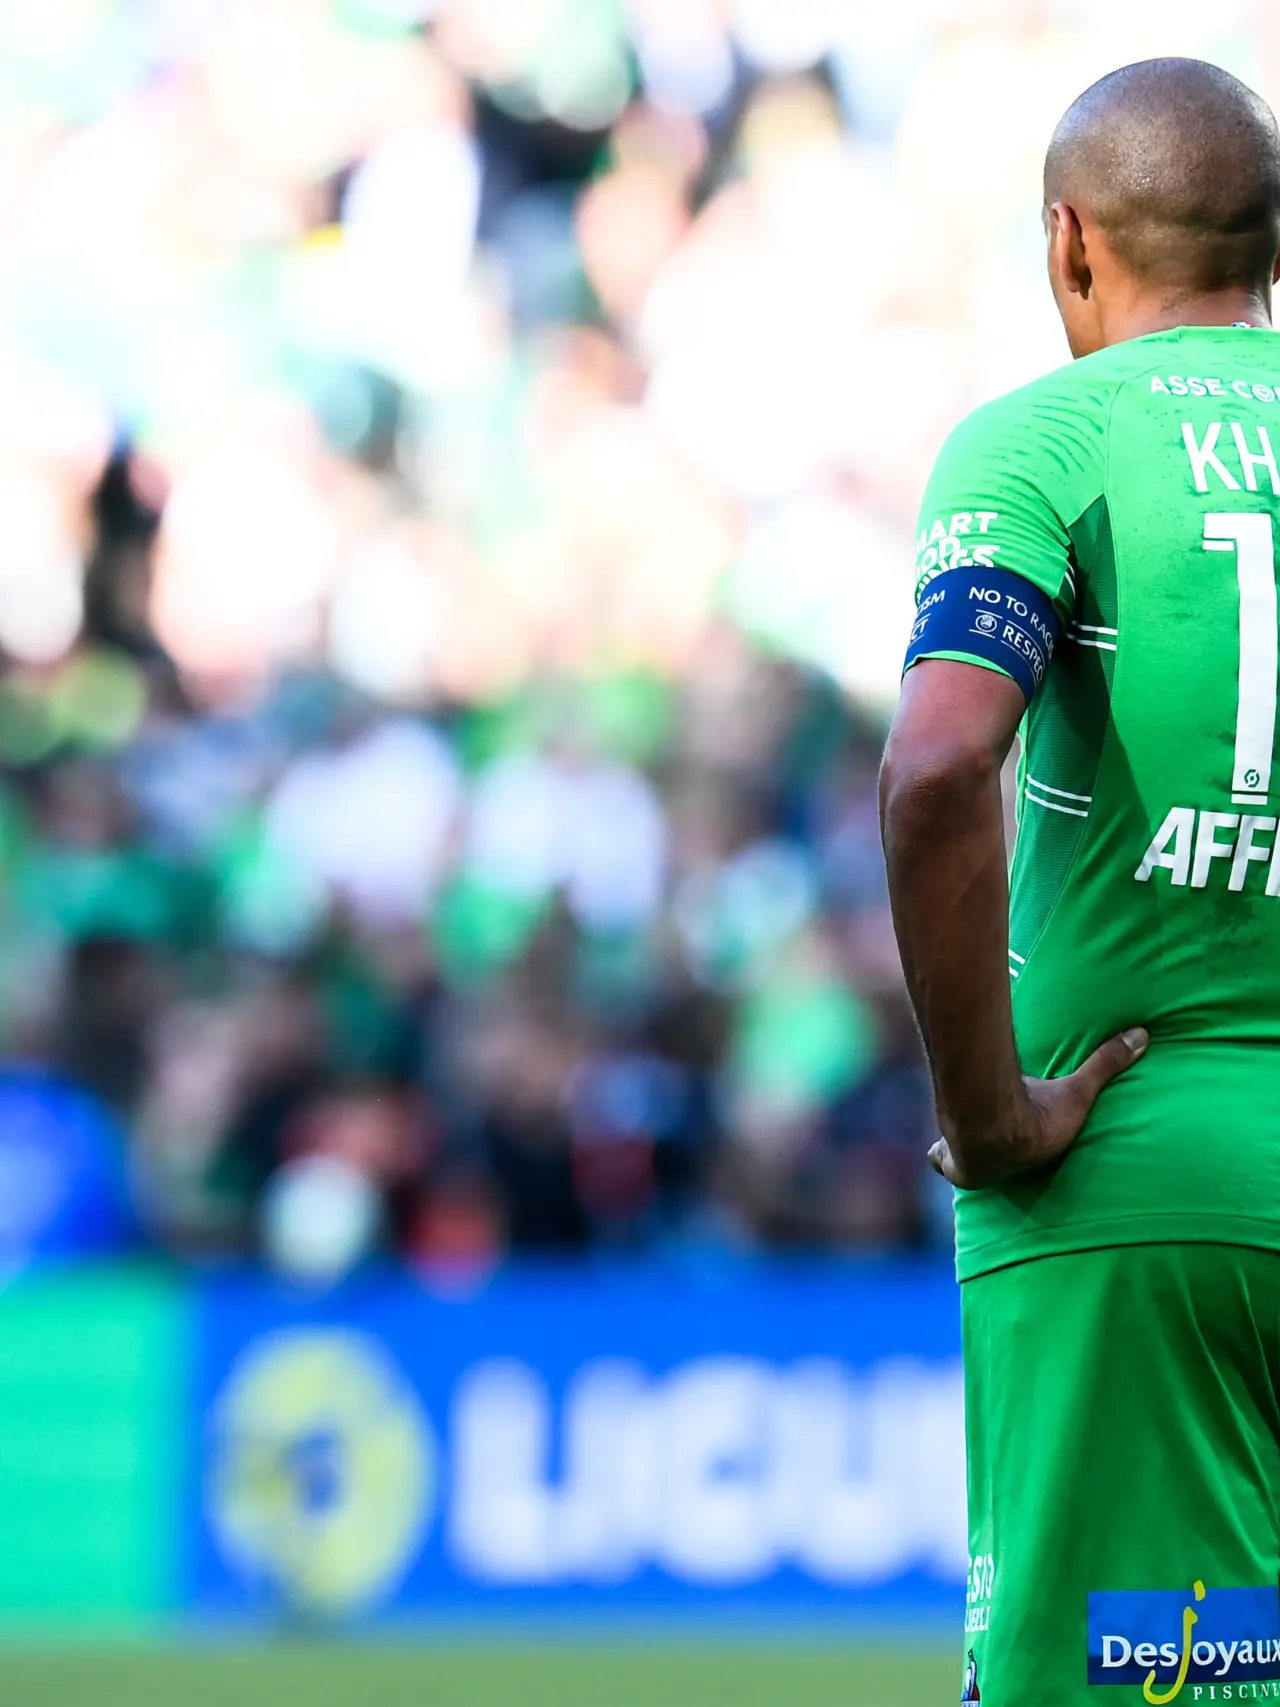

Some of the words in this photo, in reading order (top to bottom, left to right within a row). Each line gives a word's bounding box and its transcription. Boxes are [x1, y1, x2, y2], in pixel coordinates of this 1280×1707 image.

[1150, 375, 1227, 396] ASSE
[968, 586, 1001, 604] NO
[1005, 594, 1028, 617] TO
